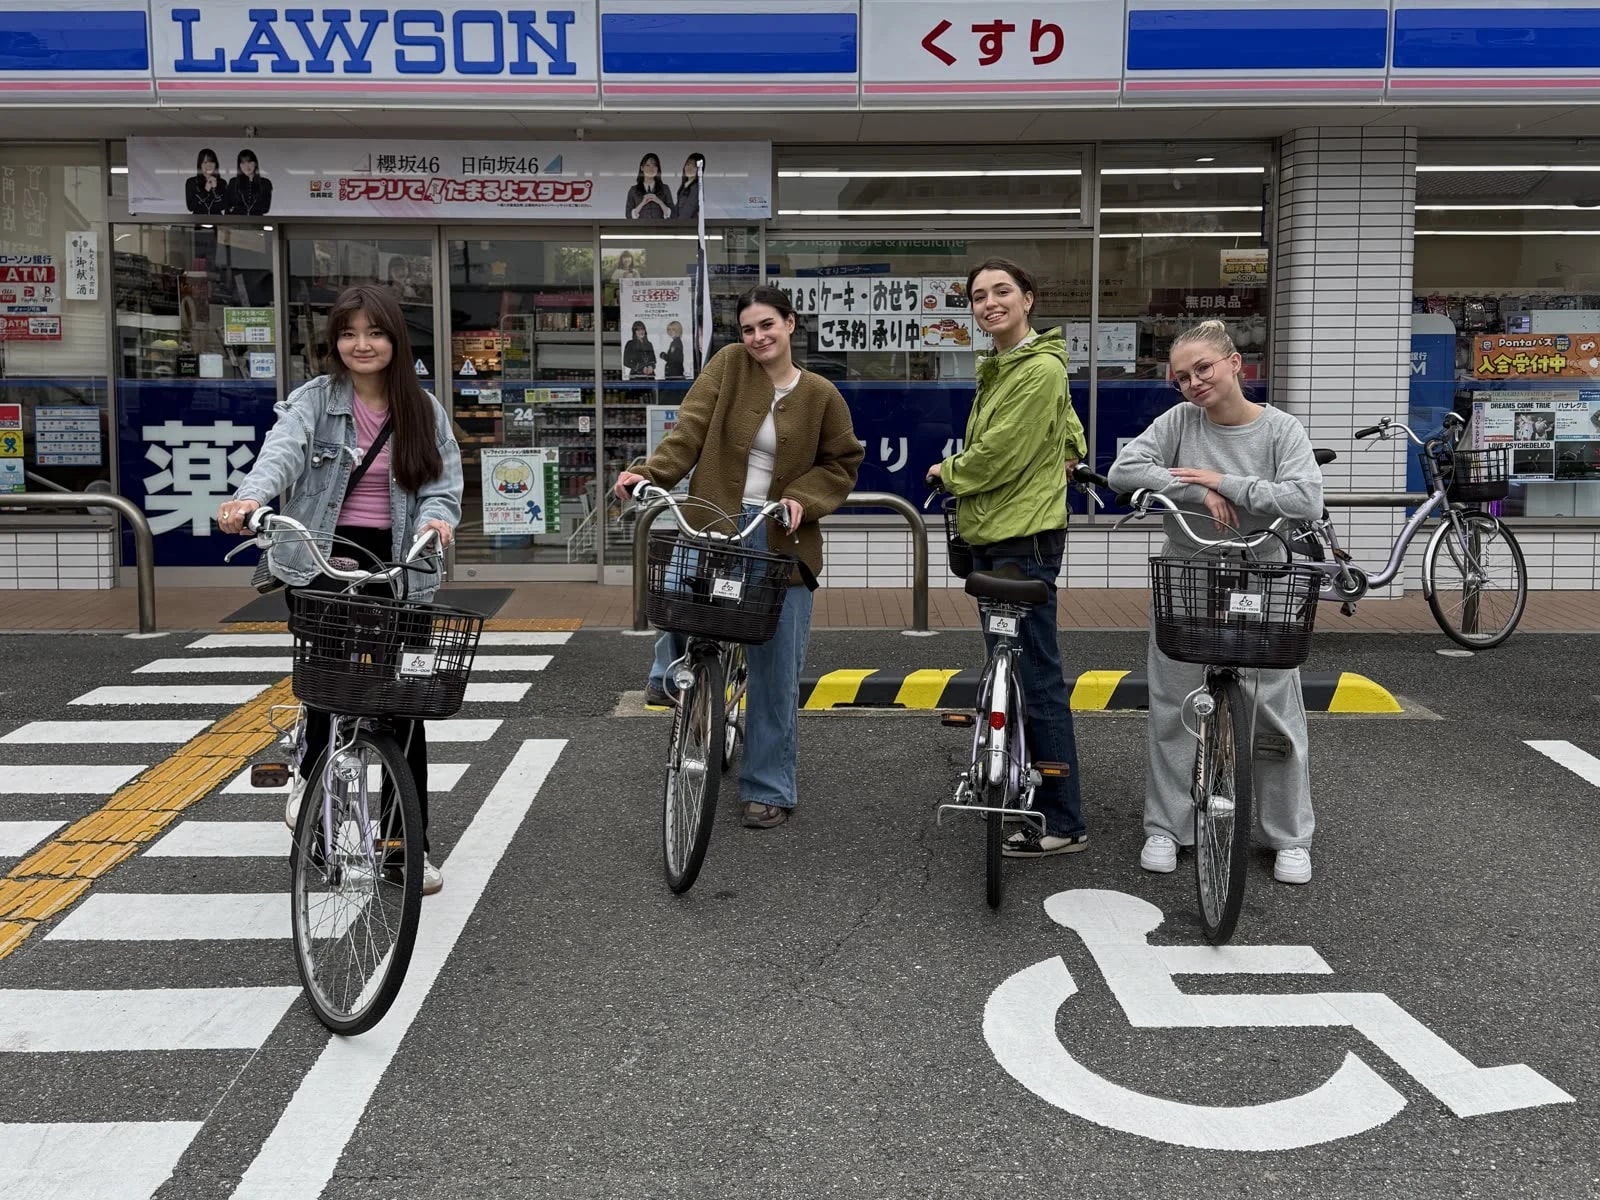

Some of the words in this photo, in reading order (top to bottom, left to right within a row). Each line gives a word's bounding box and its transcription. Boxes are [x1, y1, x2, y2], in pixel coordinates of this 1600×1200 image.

[171, 8, 577, 75] LAWSON
[920, 18, 1066, 67] くすり
[376, 154, 440, 174] 櫻坂46
[462, 155, 539, 175] 日向坂46
[346, 178, 425, 201] アプリで
[445, 180, 593, 202] たまるよスタンプ
[0, 255, 52, 265] ローソン銀行
[6, 267, 48, 282] ATM
[1185, 294, 1241, 309] 無印良品
[8, 319, 28, 328] ATM
[820, 318, 920, 350] ご予約承り中
[1498, 338, 1553, 348] Pontaパス
[1477, 352, 1567, 374] 入会受付中
[513, 408, 534, 422] 24
[142, 420, 256, 537] 薬
